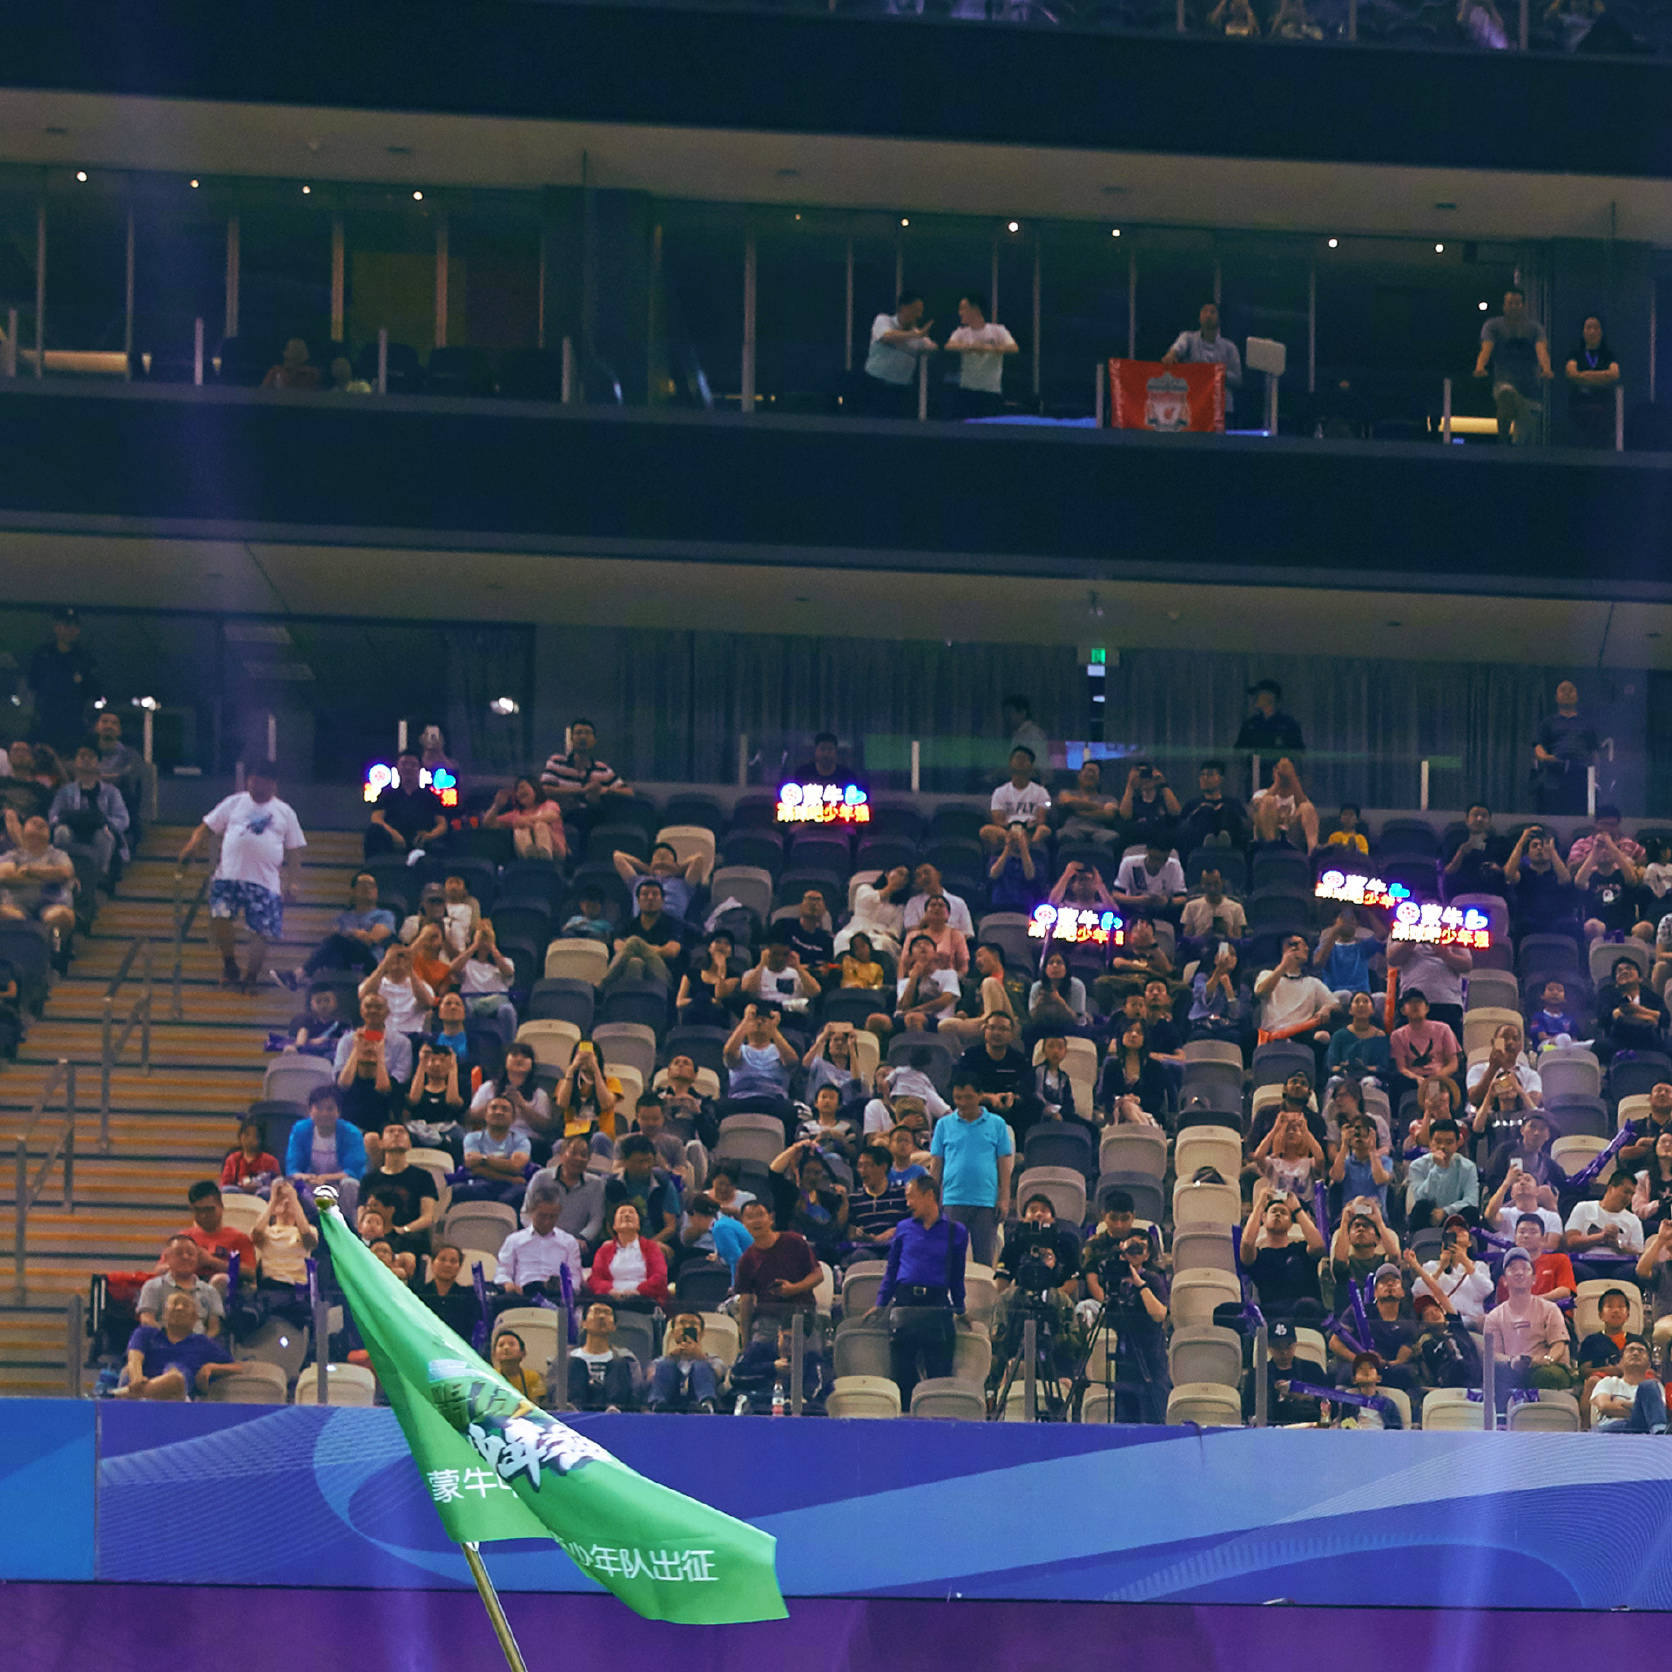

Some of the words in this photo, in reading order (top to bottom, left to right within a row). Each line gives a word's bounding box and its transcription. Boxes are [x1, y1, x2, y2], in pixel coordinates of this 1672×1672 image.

[553, 1532, 719, 1582] 少年队出征
